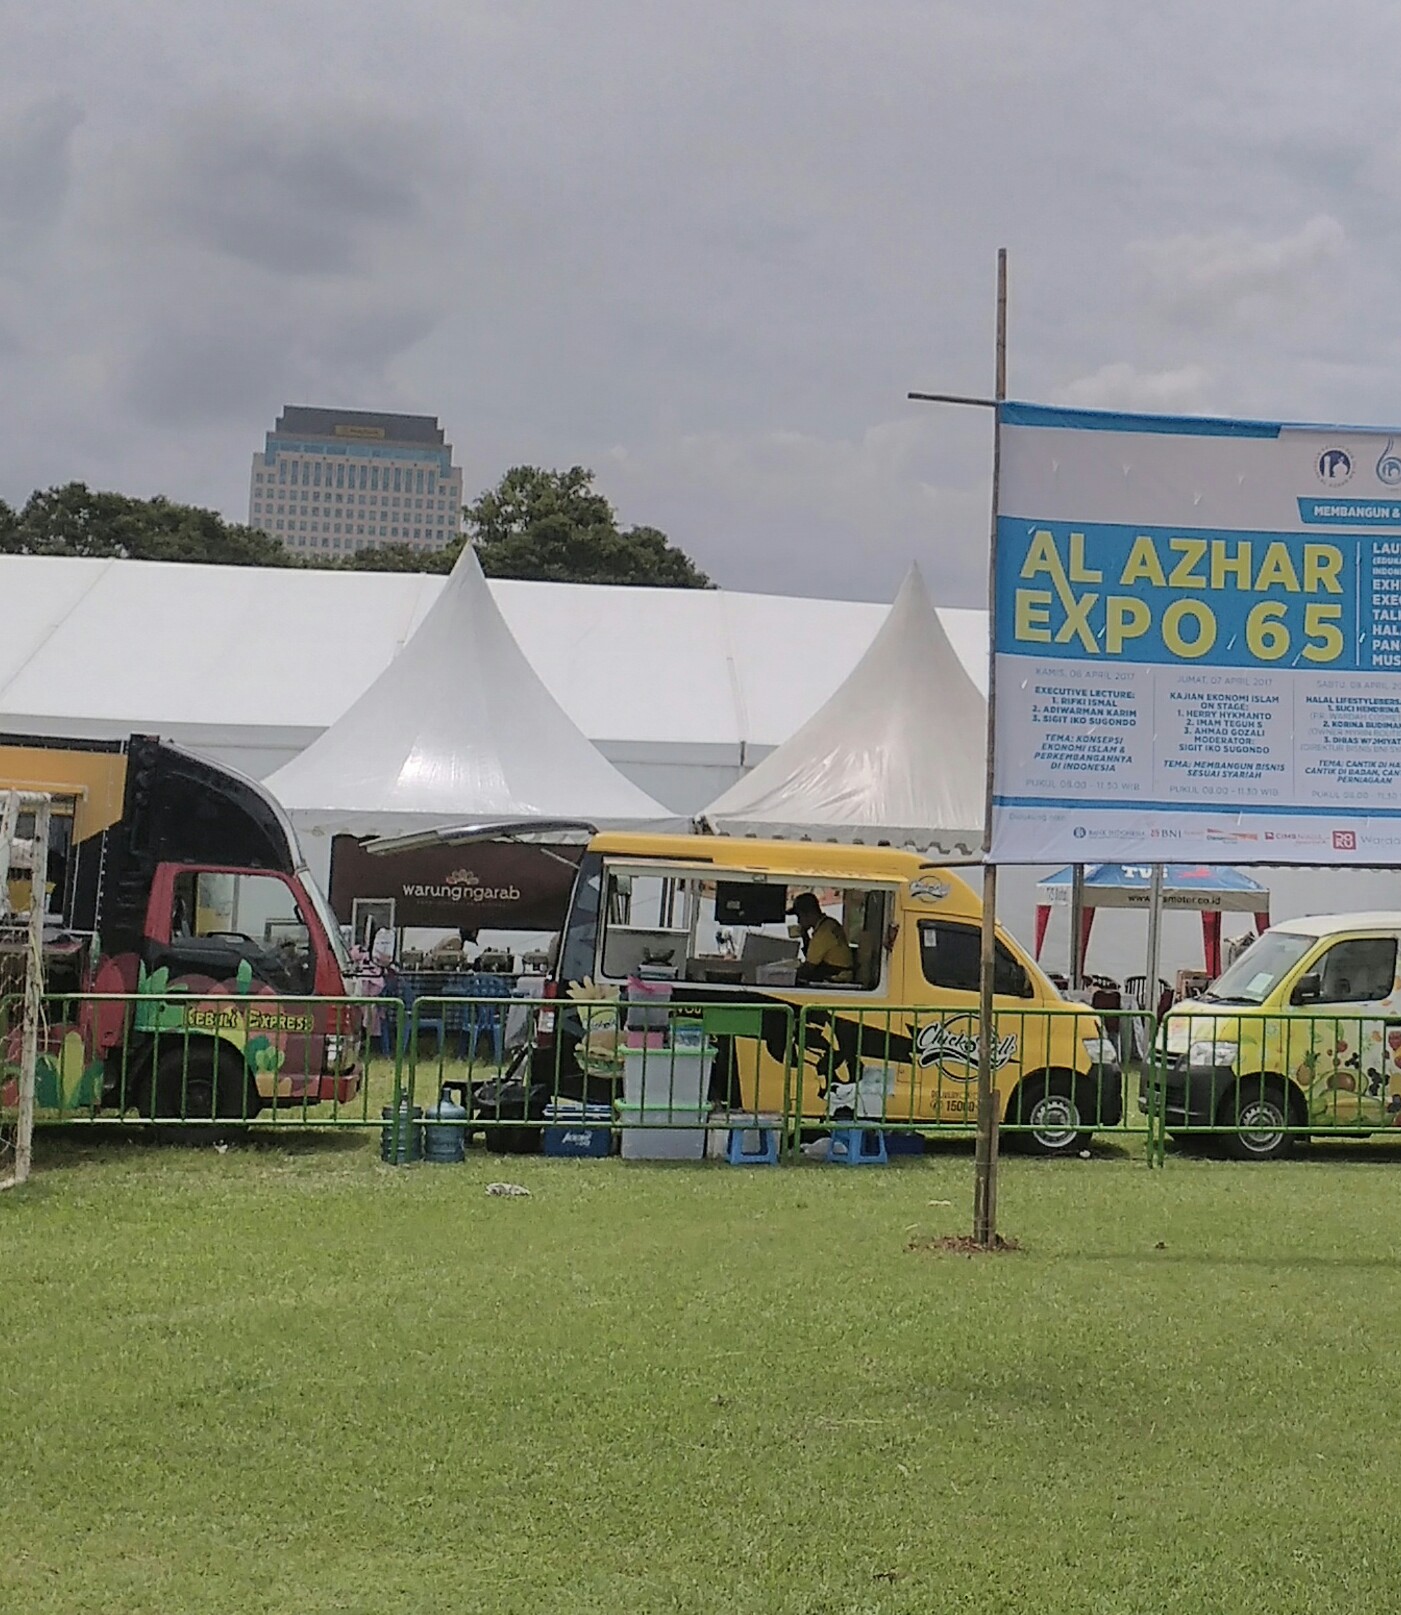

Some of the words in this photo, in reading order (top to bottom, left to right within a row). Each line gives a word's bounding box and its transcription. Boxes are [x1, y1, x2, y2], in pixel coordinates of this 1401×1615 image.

[1314, 505, 1390, 518] MEMBANGUN
[1393, 507, 1400, 518] &
[1020, 530, 1103, 583] AL
[1119, 536, 1345, 594] AZHAR
[1014, 587, 1218, 659] EXPO
[1245, 600, 1345, 663] 65
[1035, 686, 1087, 696] EXECUTIVE
[1090, 689, 1135, 699] LECTURE:
[1170, 692, 1204, 700] KAJIAN
[1207, 693, 1249, 702] EKONOMI
[1251, 695, 1279, 703] ISLAM
[1306, 696, 1334, 704] HALAL
[1032, 705, 1040, 713] 2.
[1043, 706, 1104, 716] ADIWARMAN
[1106, 709, 1137, 717] KARIM
[1200, 702, 1214, 710] ON
[1217, 703, 1248, 711] STAGE:
[1186, 710, 1217, 718] HERRY
[1043, 715, 1068, 723] SIGIT
[1089, 718, 1136, 726] SUGONDO
[1197, 719, 1221, 727] IMAM
[1224, 720, 1255, 728] TEGUH
[1195, 727, 1228, 736] AHMAD
[1231, 729, 1265, 737] GOZALI
[1045, 734, 1074, 742] TEMA:
[1076, 735, 1123, 744] KONSEPSI
[1041, 743, 1086, 752] EKONOMI
[1088, 745, 1118, 753] ISLAM
[1179, 744, 1202, 752] SIGIT
[1223, 745, 1270, 754] SUGONDO
[1034, 752, 1132, 763] PERKEMBANGANNYA
[1063, 762, 1116, 772] INDONESIA
[1164, 760, 1191, 768] TEMA:
[1193, 760, 1253, 770] MEMBANGUN
[1255, 763, 1285, 772] BISNIS
[1346, 760, 1376, 768] CANTIK
[1187, 769, 1220, 778] SESUAI
[1222, 770, 1262, 779] SYARIAH
[1305, 767, 1336, 775] CANTIK
[1161, 829, 1182, 838] BNI
